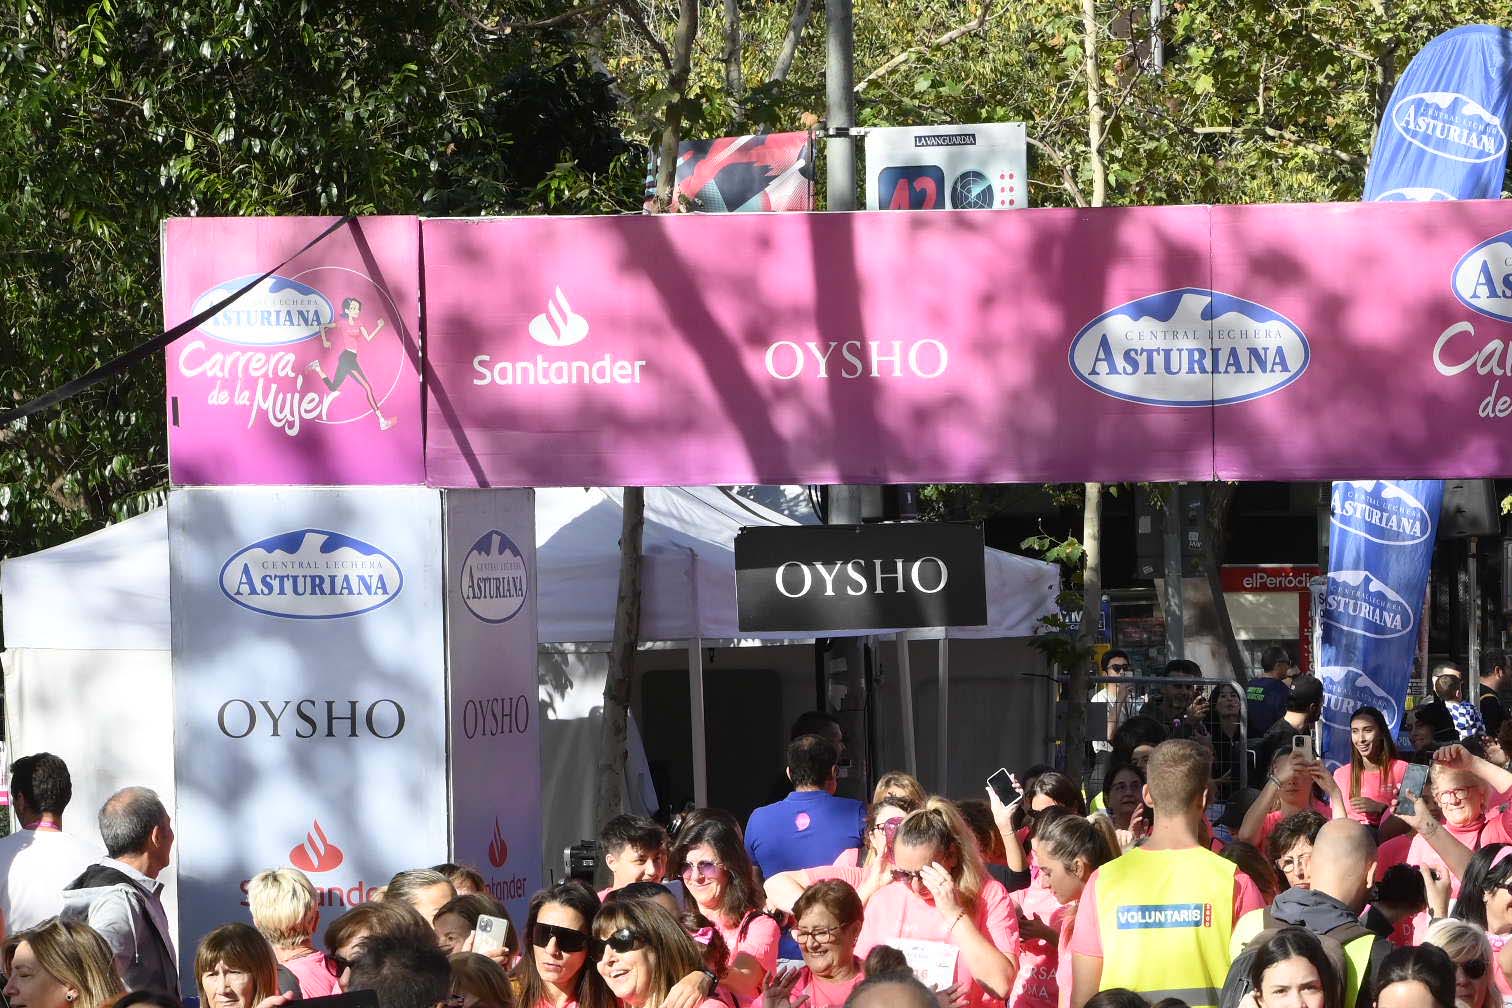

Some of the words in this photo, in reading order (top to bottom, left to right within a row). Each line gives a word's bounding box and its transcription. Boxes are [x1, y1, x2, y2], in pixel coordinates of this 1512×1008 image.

[1125, 329, 1200, 341] CENTRAL
[1207, 328, 1283, 340] LECHERA
[178, 340, 296, 378] Carrera
[473, 354, 646, 387] Santander
[764, 339, 949, 380] OYSHO
[1087, 333, 1292, 377] ASTURIANA
[207, 381, 229, 405] de
[234, 379, 251, 406] la
[247, 373, 340, 436] Mujer
[1478, 379, 1512, 419] de
[1330, 489, 1421, 537] ASTURIANA
[234, 563, 390, 597] ASTURIANA
[262, 559, 321, 569] CENTRAL
[325, 559, 384, 570] LECHERA
[775, 556, 949, 598] OYSHO
[465, 572, 524, 602] ASTURIANA
[1325, 594, 1402, 630] STURIANA
[216, 698, 406, 740] OYSHO
[462, 695, 530, 741] OYSHO
[1118, 910, 1201, 924] VOLUNTARIS
